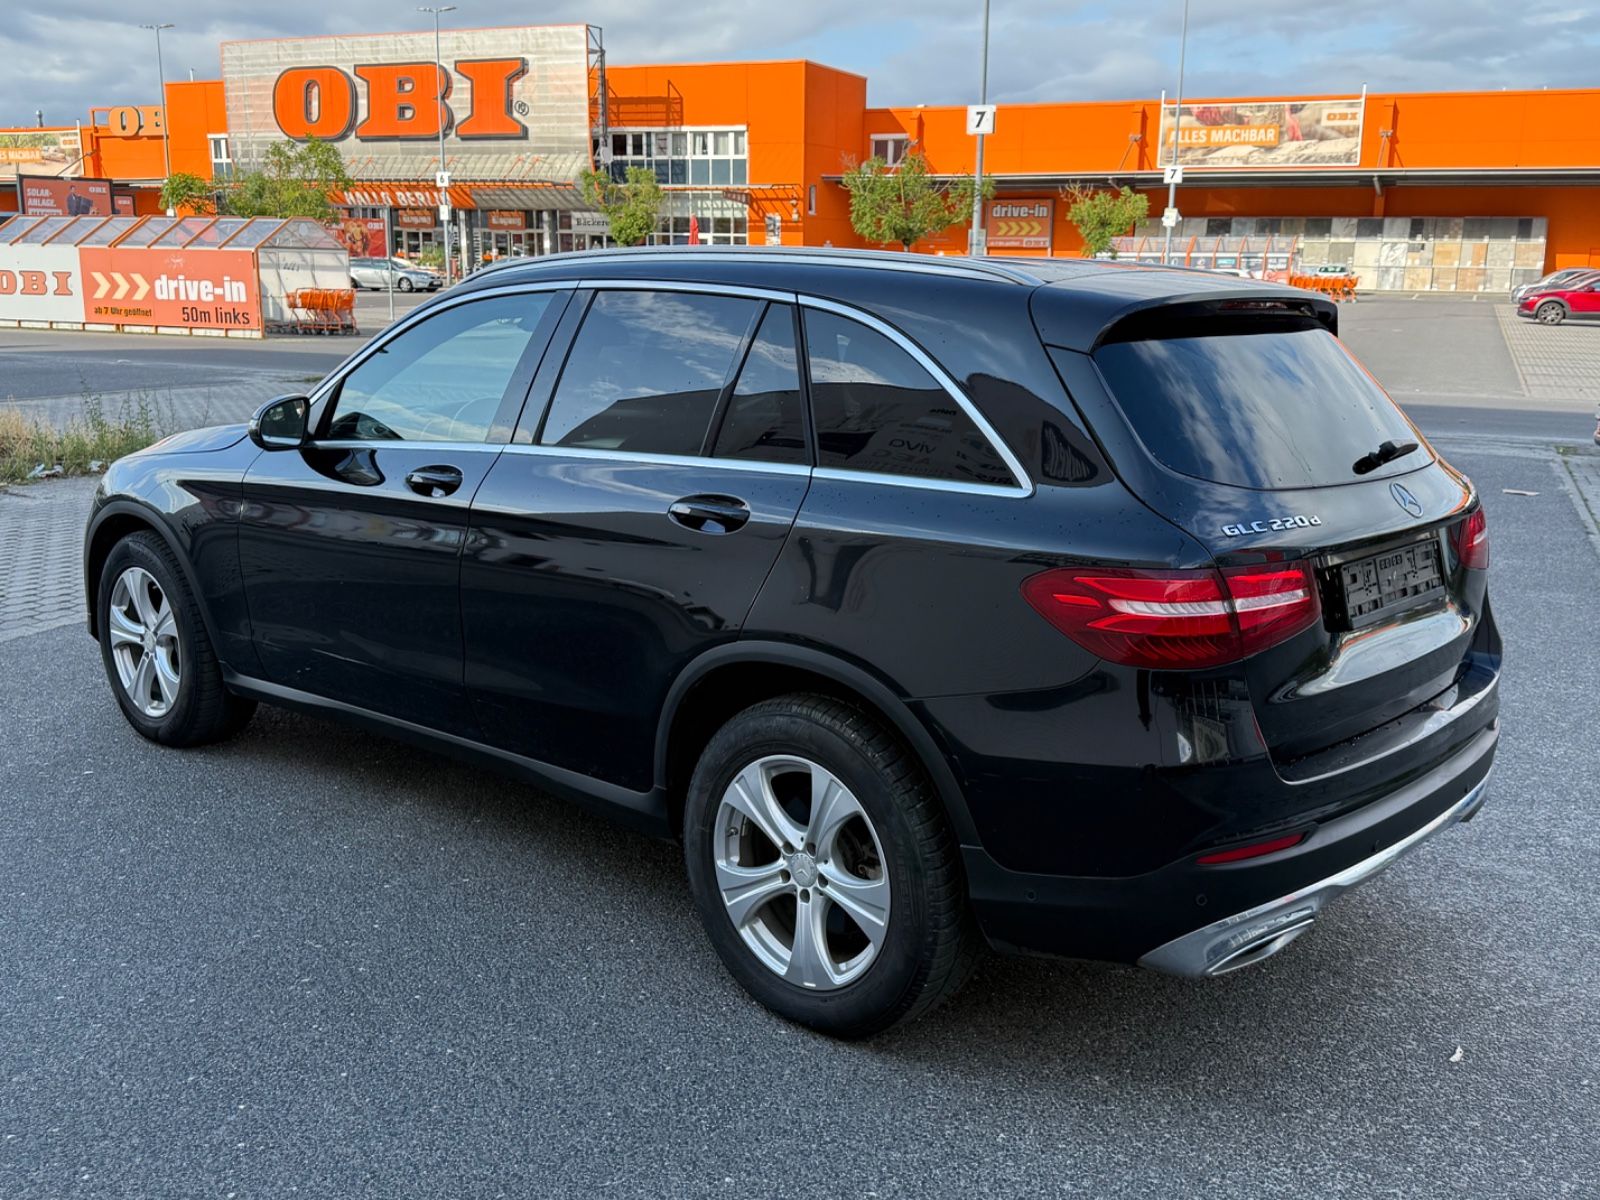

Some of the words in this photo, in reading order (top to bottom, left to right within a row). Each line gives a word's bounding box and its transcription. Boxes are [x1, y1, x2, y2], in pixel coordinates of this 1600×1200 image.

[273, 57, 528, 141] OBI
[975, 111, 987, 128] 7
[1326, 112, 1359, 121] OBI
[1168, 129, 1207, 144] ALLES
[1210, 128, 1275, 143] MACHBAR
[439, 174, 445, 184] 6
[1170, 168, 1178, 180] 7
[26, 187, 53, 197] SOLAR-
[343, 191, 393, 206] HALLO
[395, 191, 451, 207] BERLIN
[992, 203, 1048, 217] drive-in
[367, 222, 385, 230] OBI
[0, 269, 73, 296] OBI
[153, 274, 248, 303] drive-in
[103, 306, 109, 315] 7
[181, 306, 211, 323] 50m
[215, 307, 250, 325] links
[1222, 520, 1268, 537] GLC
